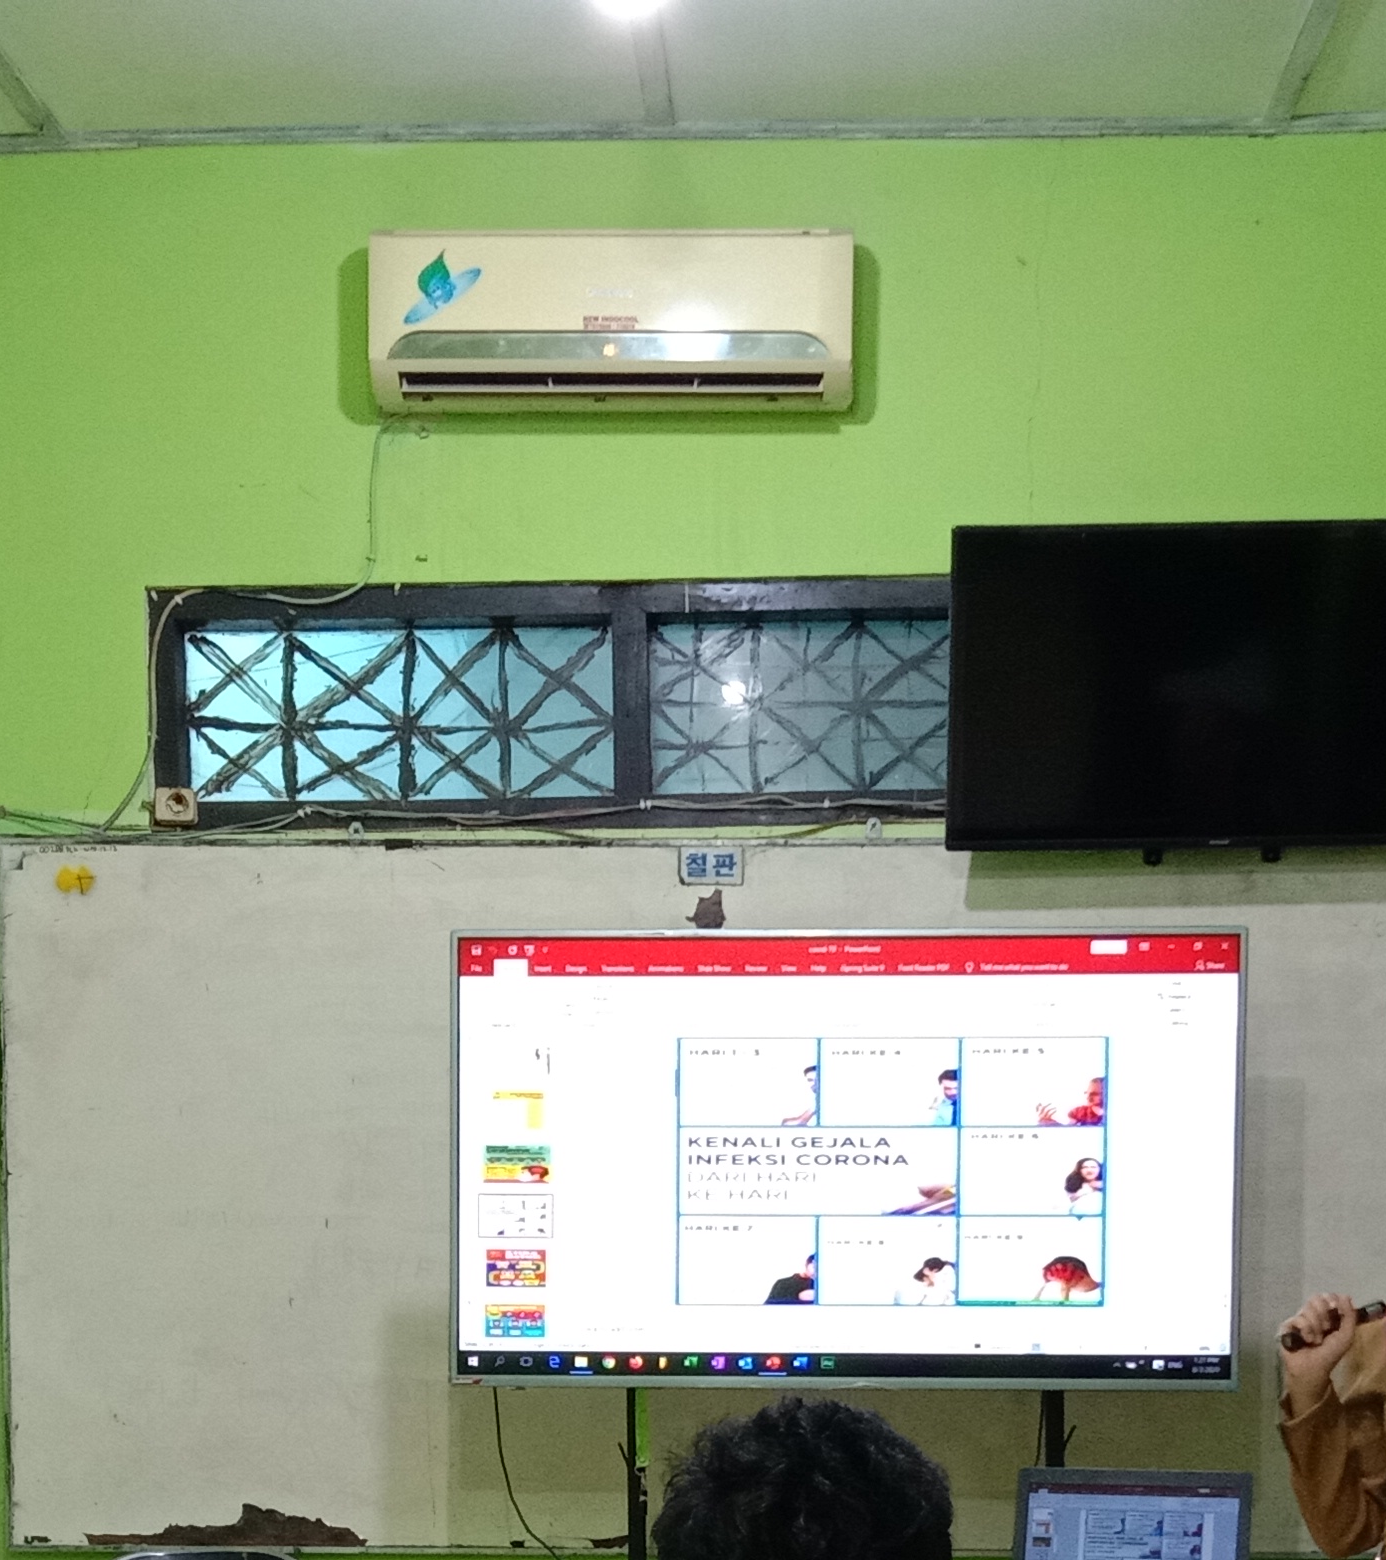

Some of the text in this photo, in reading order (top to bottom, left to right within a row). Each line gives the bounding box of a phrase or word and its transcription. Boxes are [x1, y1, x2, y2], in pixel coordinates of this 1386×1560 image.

[686, 853, 737, 877] 칠판
[688, 1137, 891, 1148] KENALI GEJALA
[688, 1154, 909, 1166] INFEKSI CORONA
[688, 1171, 816, 1183] DARI HARI
[729, 1189, 788, 1200] HARI
